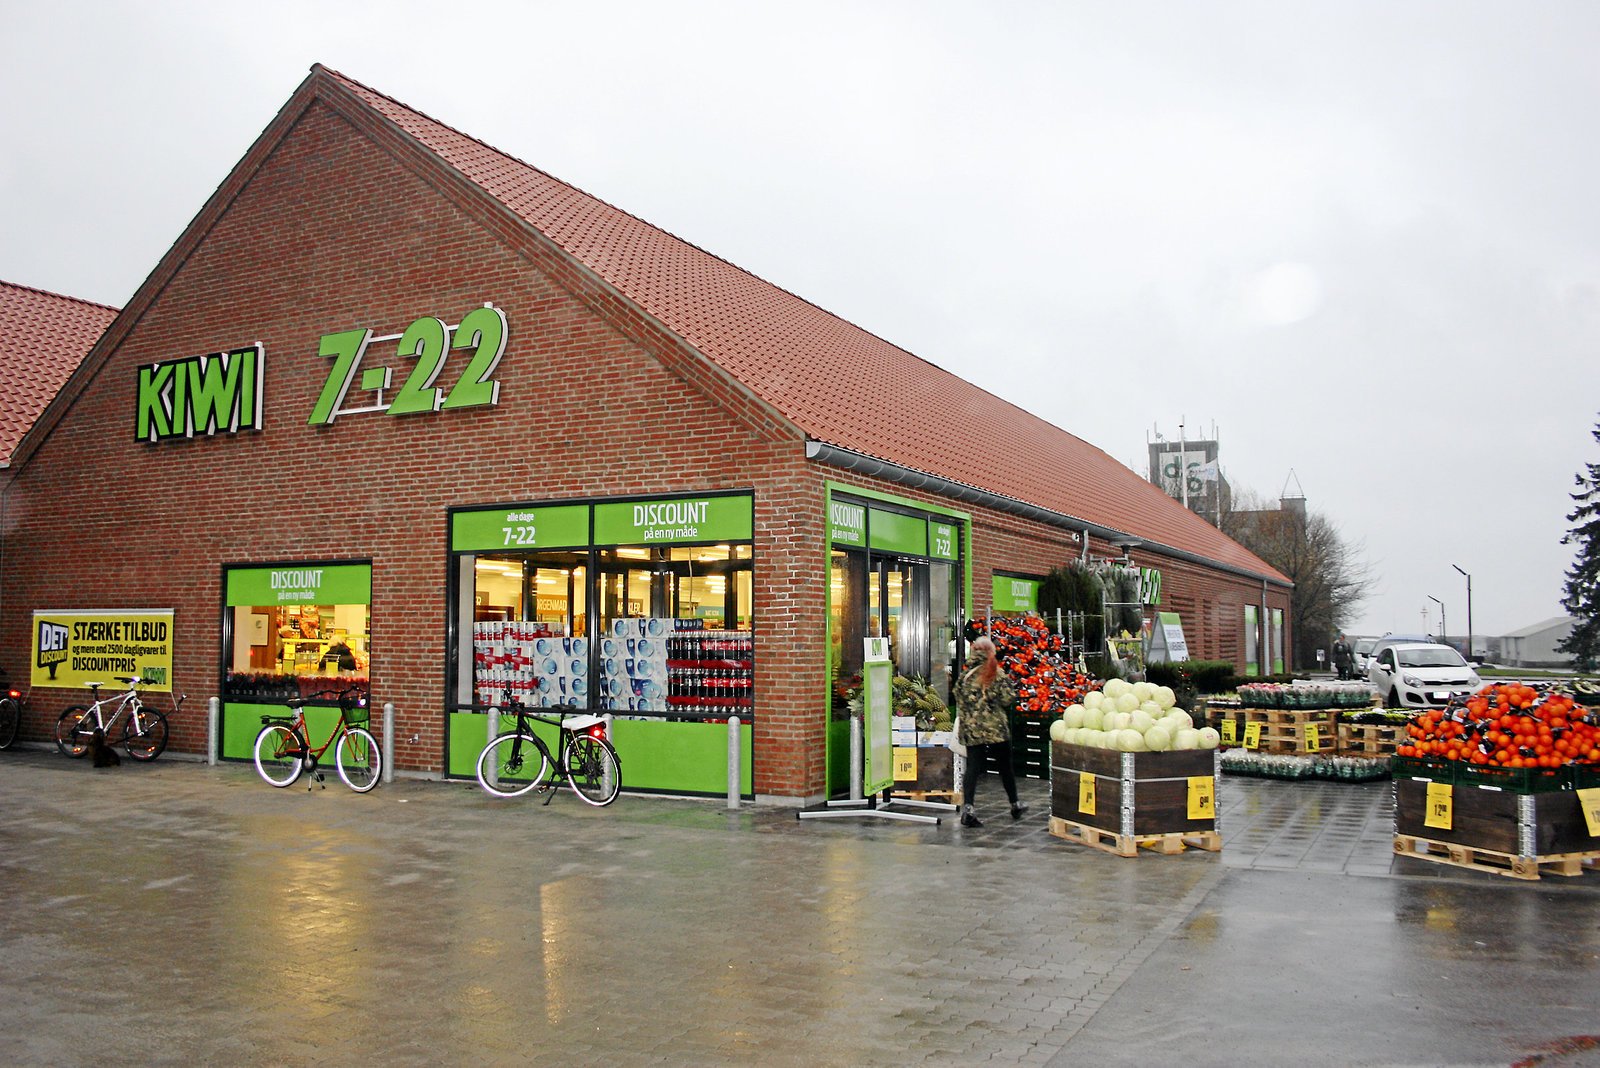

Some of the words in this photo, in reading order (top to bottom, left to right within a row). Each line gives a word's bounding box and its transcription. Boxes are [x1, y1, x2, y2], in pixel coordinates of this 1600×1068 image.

[307, 304, 508, 425] 7-22
[135, 345, 265, 442] KIWI
[506, 512, 518, 522] alle
[518, 511, 534, 523] dage
[633, 501, 709, 526] DISCOUNT
[502, 526, 536, 545] 7-22
[644, 527, 653, 541] på
[654, 530, 664, 539] en
[665, 529, 675, 540] ny
[676, 525, 698, 538] måde
[936, 538, 951, 556] 7-22
[271, 570, 323, 589] DISCOUNT
[73, 622, 120, 641] STÆRKE
[123, 622, 166, 641] TILBUD
[41, 650, 68, 664] DISCOUNT
[72, 645, 80, 655] og
[81, 645, 95, 654] mere
[96, 644, 107, 654] end
[107, 644, 123, 654] 2500
[124, 644, 159, 656] dagligvarer
[159, 644, 167, 655] til
[72, 657, 136, 673] DISCOUNTPRIS
